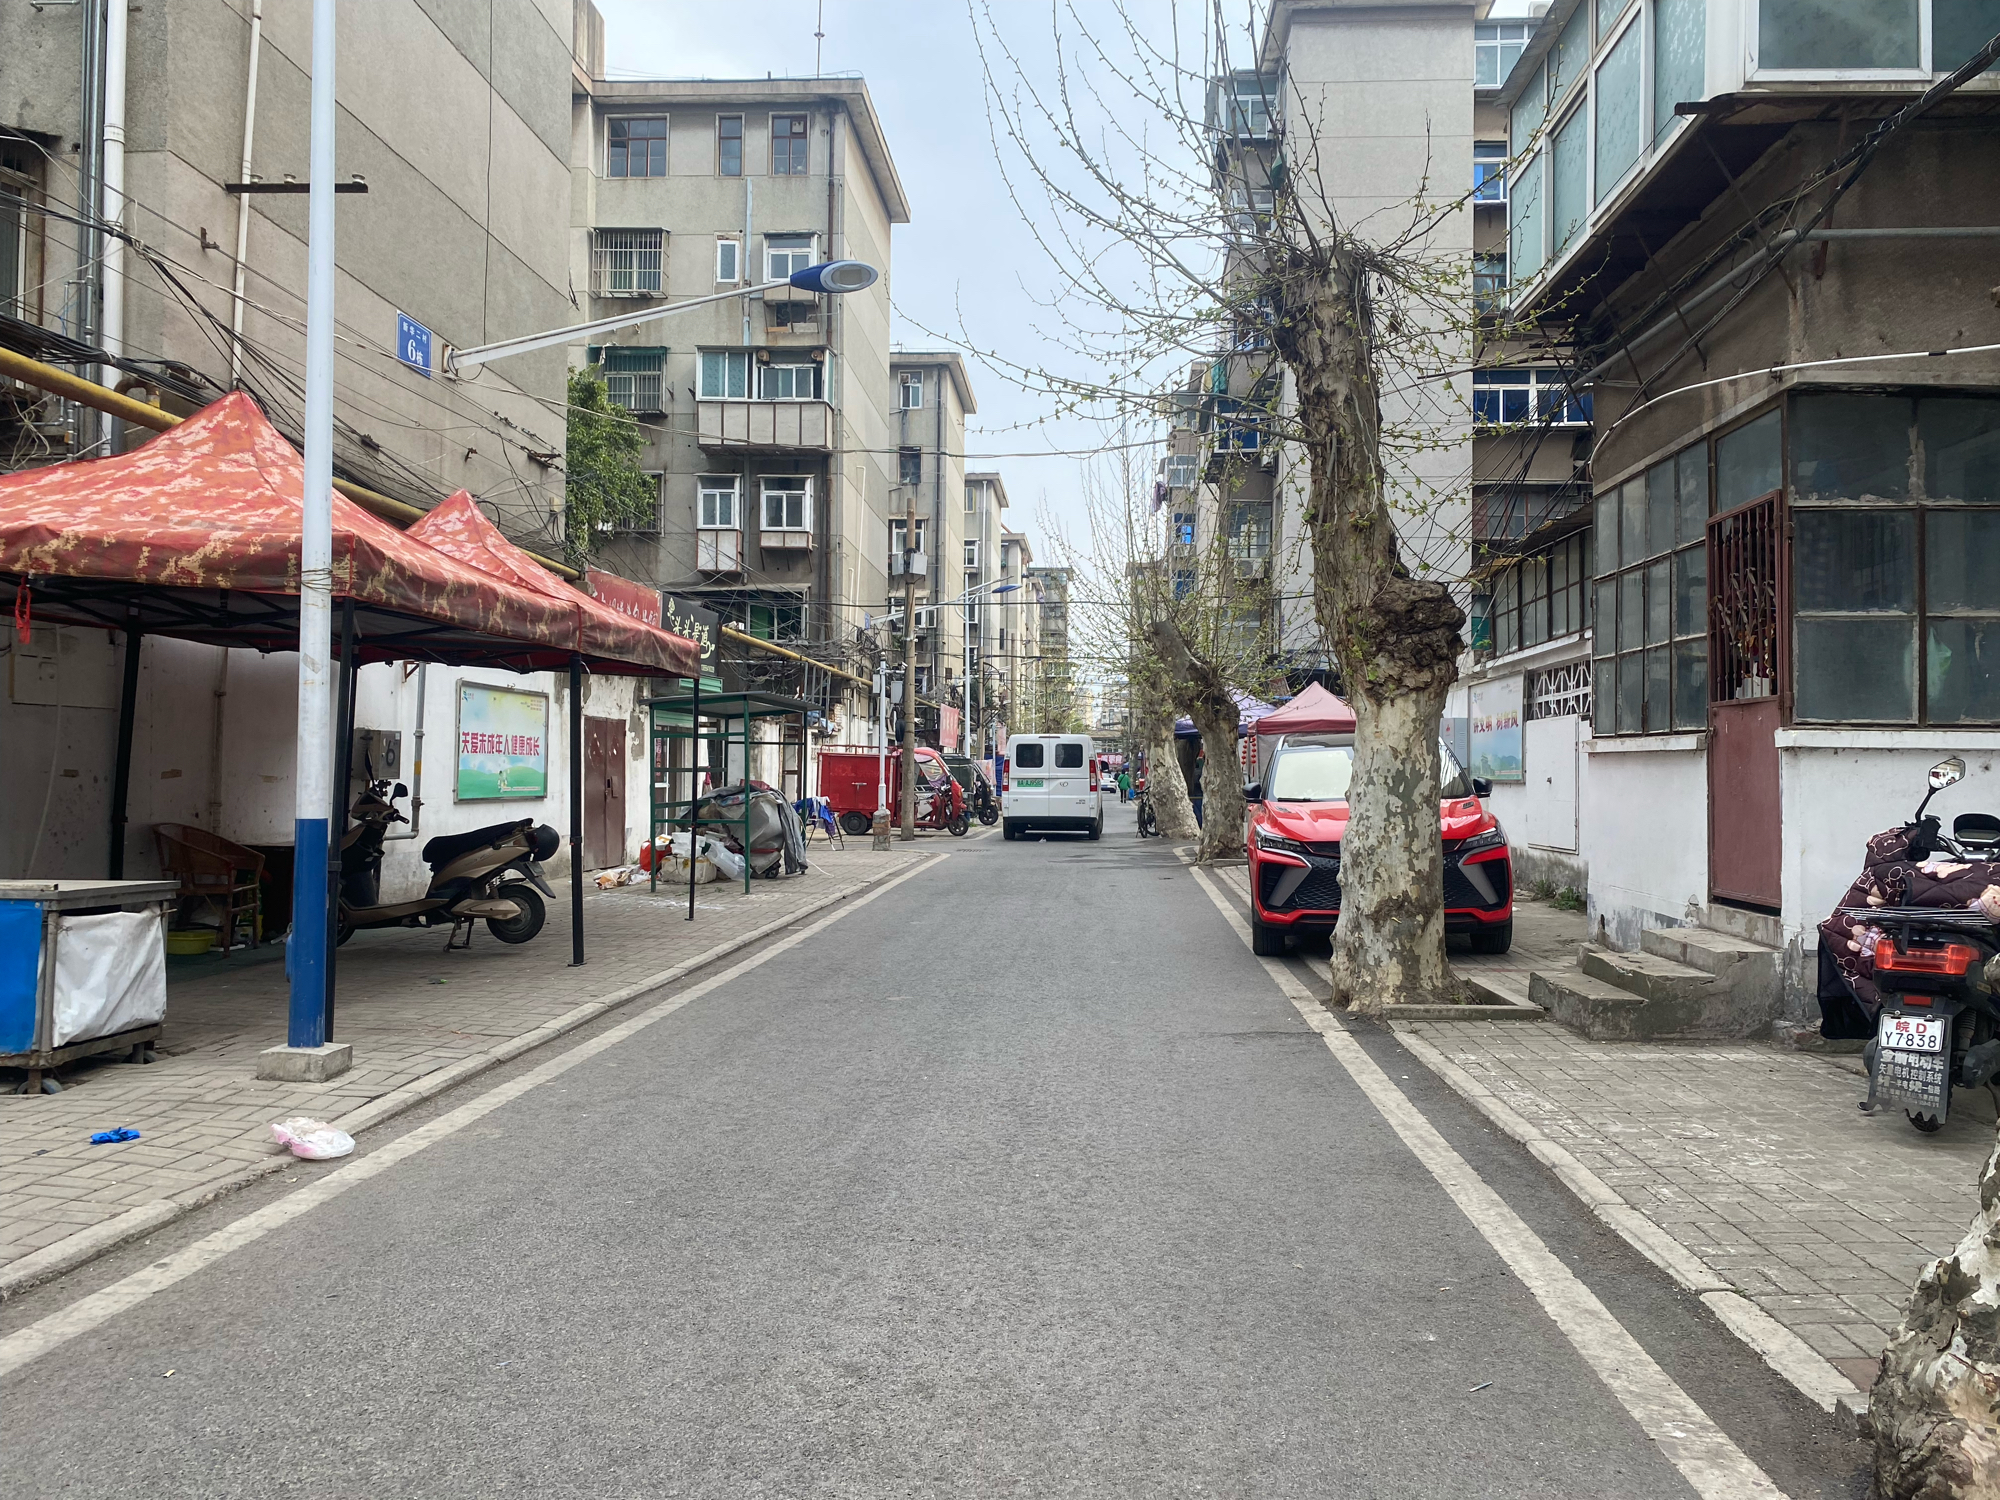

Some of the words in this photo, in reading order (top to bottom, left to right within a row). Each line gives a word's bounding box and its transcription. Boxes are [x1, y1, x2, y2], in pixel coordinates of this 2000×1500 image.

[407, 339, 424, 366] 6栋
[386, 740, 396, 767] 6
[461, 731, 540, 756] 关爱未成年人健康成长
[1885, 1031, 1938, 1049] Y7838
